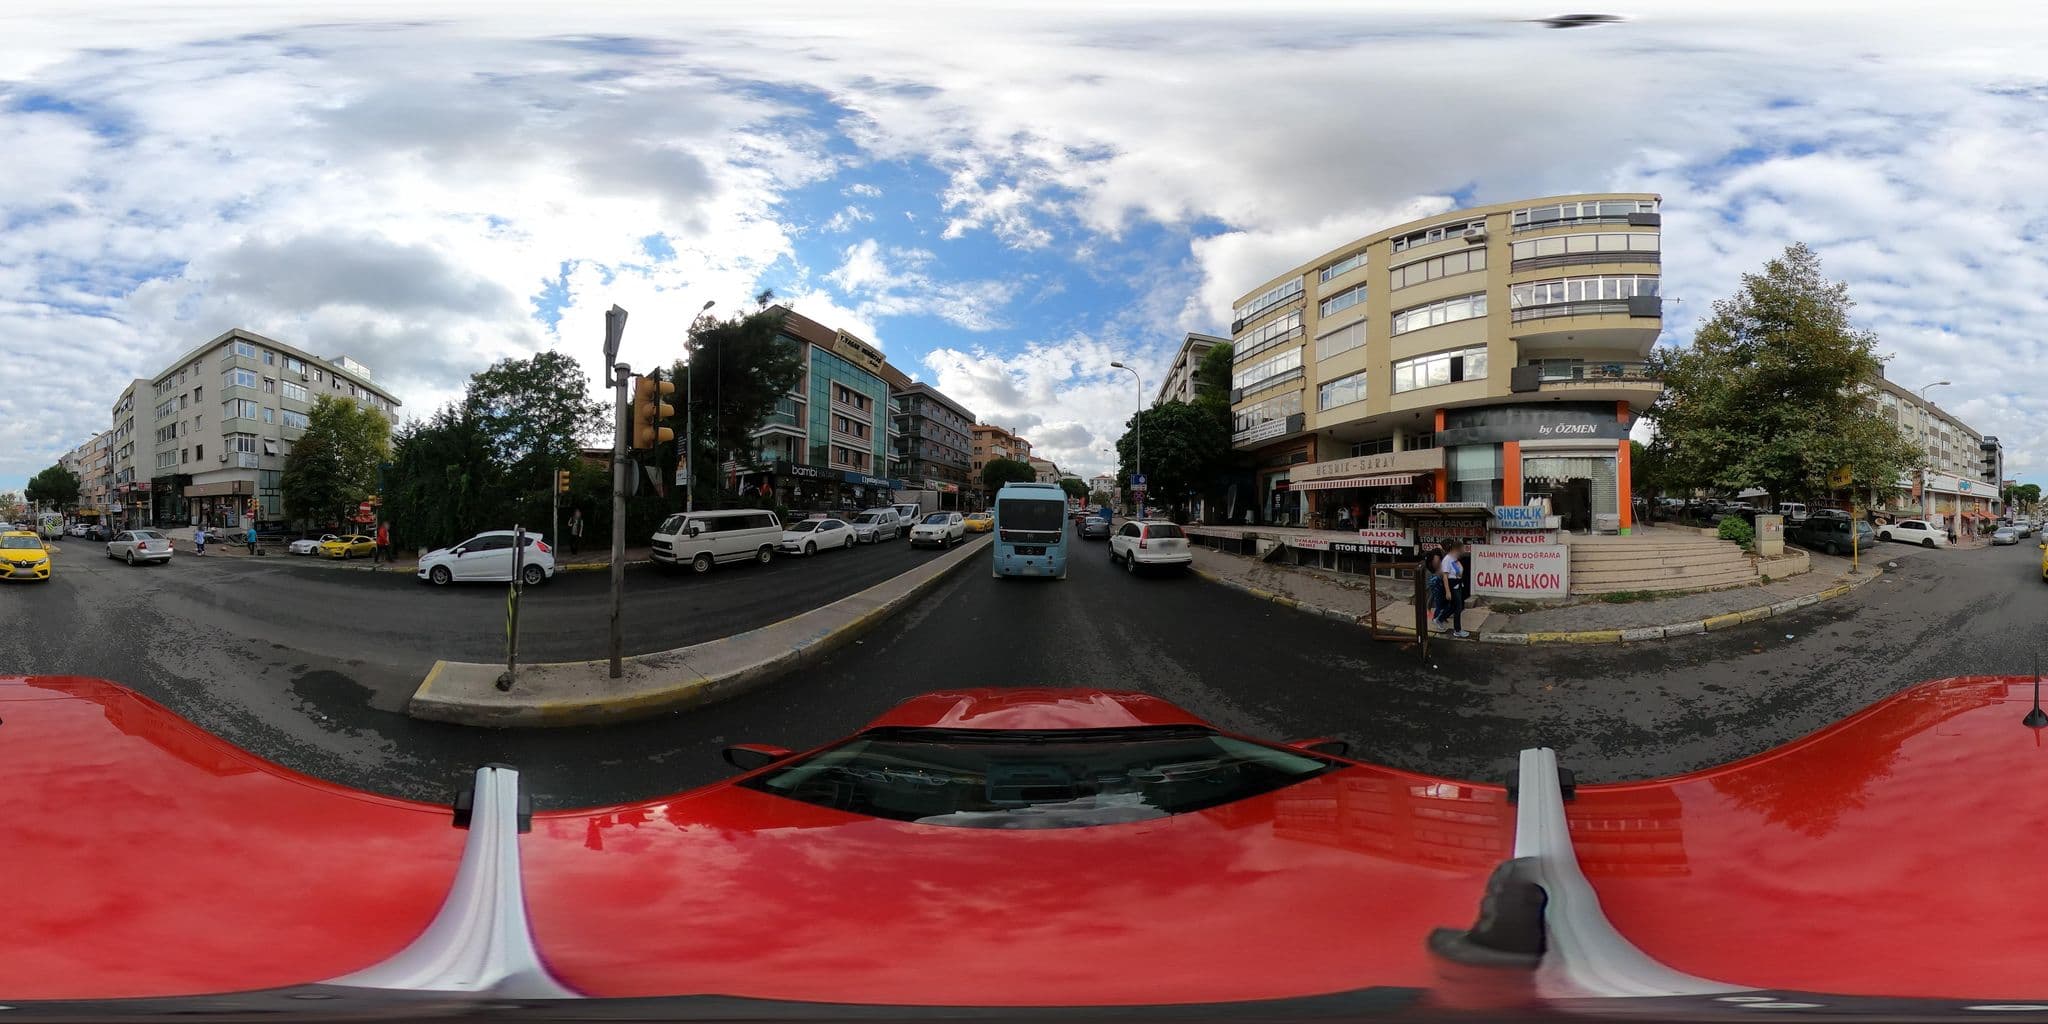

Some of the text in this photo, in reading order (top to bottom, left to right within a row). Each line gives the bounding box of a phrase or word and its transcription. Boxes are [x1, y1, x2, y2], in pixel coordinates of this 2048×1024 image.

[1539, 422, 1598, 435] by ÖZMEN
[791, 465, 818, 477] bambi
[1361, 531, 1405, 539] BALKON
[1501, 535, 1546, 544] PANCUR
[1335, 544, 1357, 552] STOR
[1502, 562, 1535, 570] PANCUR
[1477, 571, 1560, 589] CAM BALKON
